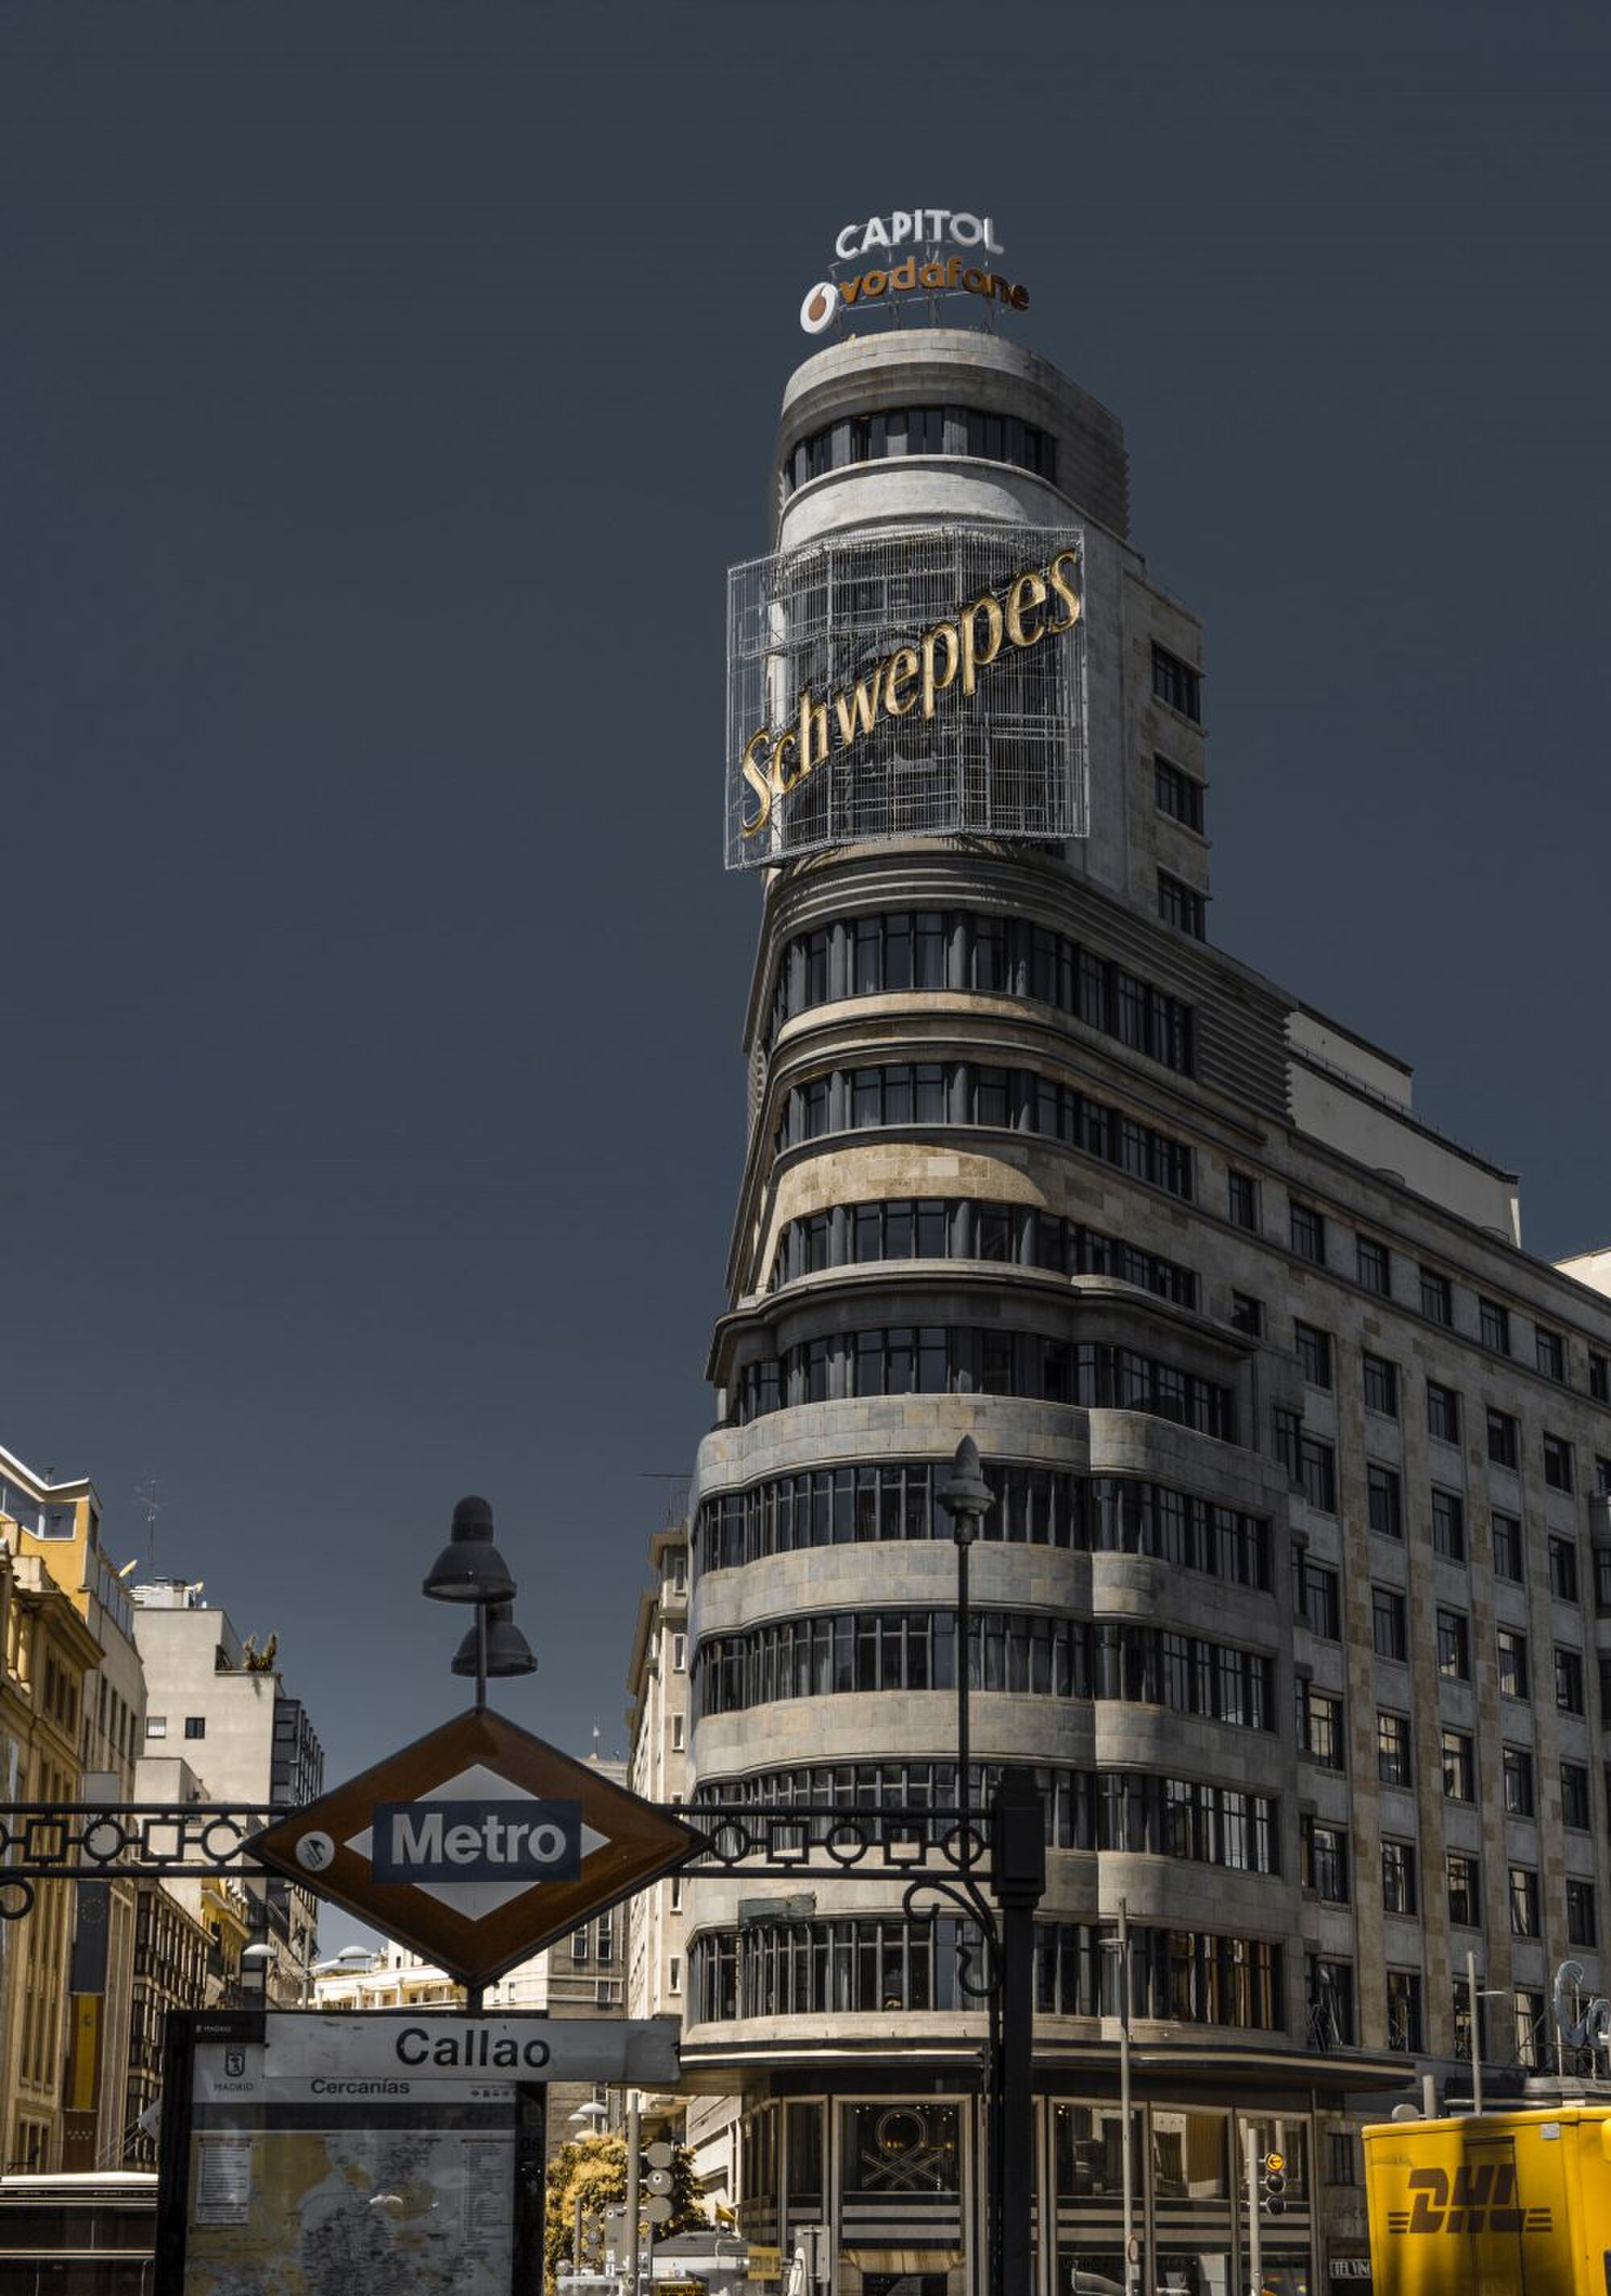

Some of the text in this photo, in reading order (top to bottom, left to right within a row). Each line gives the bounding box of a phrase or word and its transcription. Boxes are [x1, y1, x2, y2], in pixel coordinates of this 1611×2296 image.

[835, 209, 1004, 259] CAPITOL
[839, 256, 1031, 311] vodafone
[742, 548, 1082, 839] Schweppes
[391, 1813, 566, 1864] Metro
[396, 2028, 550, 2068] Callao
[213, 2083, 254, 2091] MADRID
[311, 2078, 411, 2095] Cercanías
[1408, 2164, 1527, 2234] DHL
